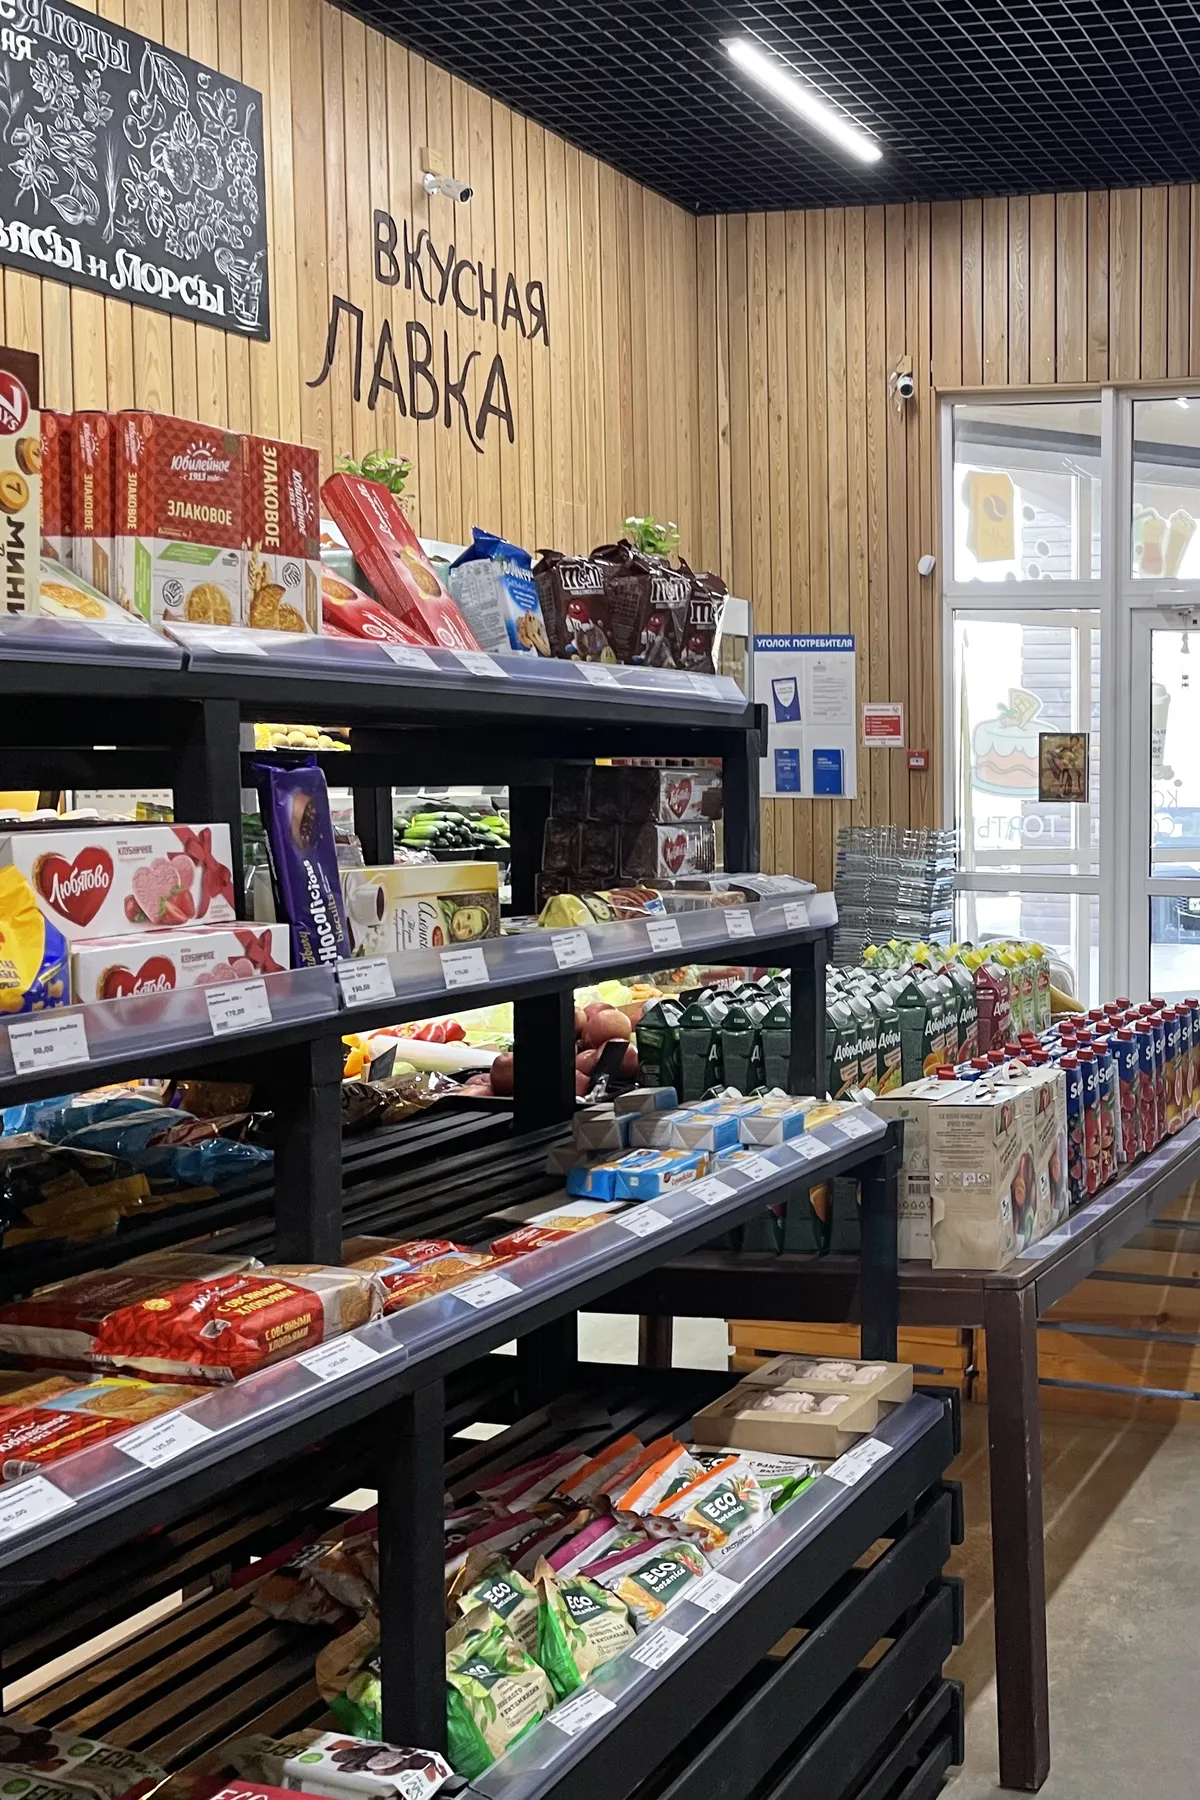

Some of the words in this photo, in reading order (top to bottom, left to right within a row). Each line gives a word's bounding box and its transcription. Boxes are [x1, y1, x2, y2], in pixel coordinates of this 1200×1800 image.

[373, 209, 550, 347] ВКУСНАЯ
[306, 294, 515, 453] ЛАВКА
[170, 455, 231, 472] Юбилейное
[84, 473, 94, 531] ЗЛАКОВОЕ
[127, 472, 138, 530] ЗЛАКОВОЕ
[262, 445, 280, 548] ЗЛАКОВОЕ
[167, 500, 233, 526] ЗЛАКОВОЕ
[757, 639, 791, 648] УГОЛОК
[793, 639, 853, 648] ПОТРЕБИТЕЛЯ
[50, 864, 109, 913] Любятово
[327, 893, 344, 943] biscuits
[271, 1312, 312, 1338] ОВСЯНЫМИ
[268, 1326, 309, 1353] ХЛОПЬЯМИ
[702, 1491, 737, 1517] ECO
[715, 1504, 745, 1525] botanica
[639, 1561, 678, 1585] ECO
[651, 1568, 686, 1594] botanica
[483, 1582, 511, 1603] ECO
[566, 1595, 594, 1610] ECO
